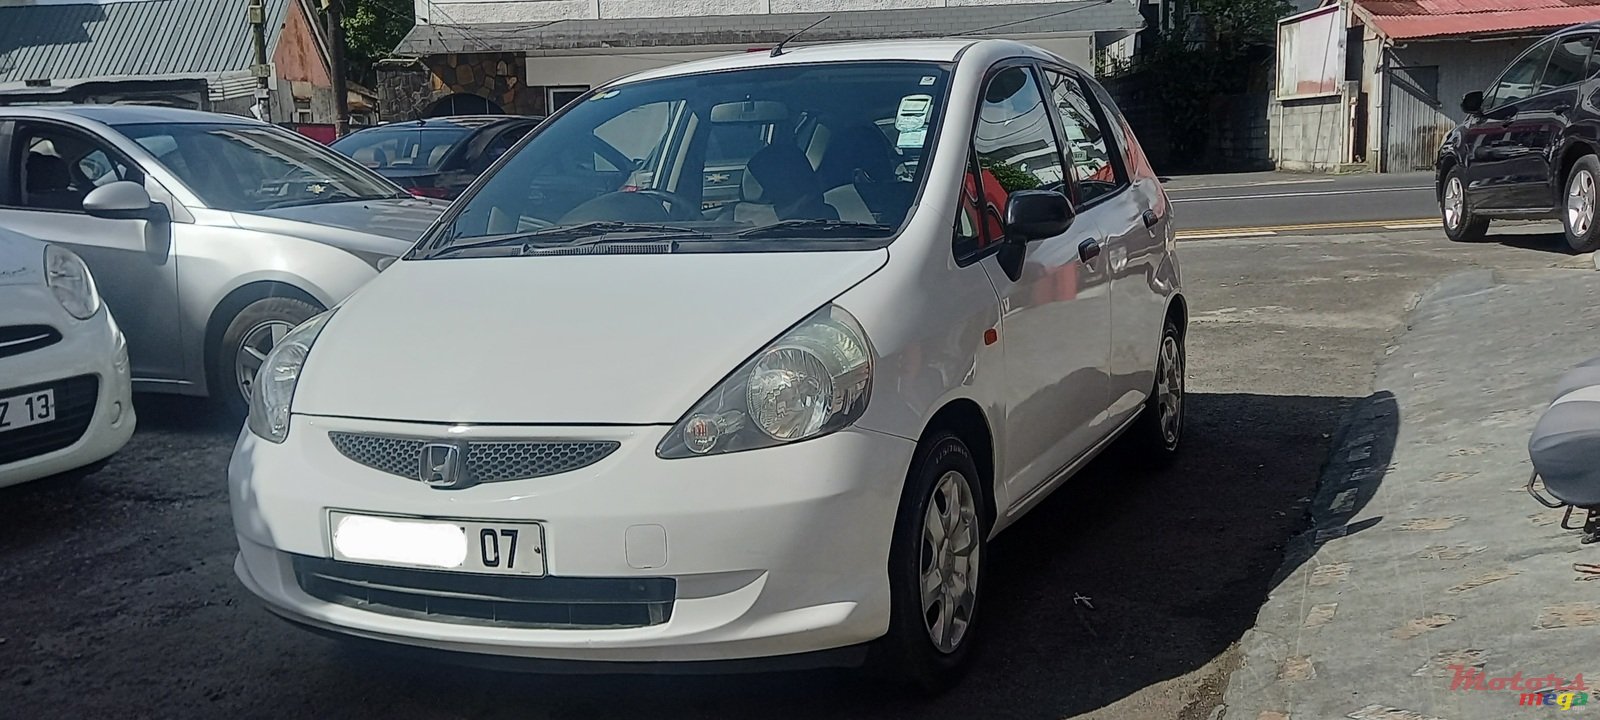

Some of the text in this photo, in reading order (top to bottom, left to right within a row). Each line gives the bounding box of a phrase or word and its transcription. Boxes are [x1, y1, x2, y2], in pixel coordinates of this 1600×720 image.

[0, 394, 50, 427] Z 13
[480, 528, 519, 568] 07
